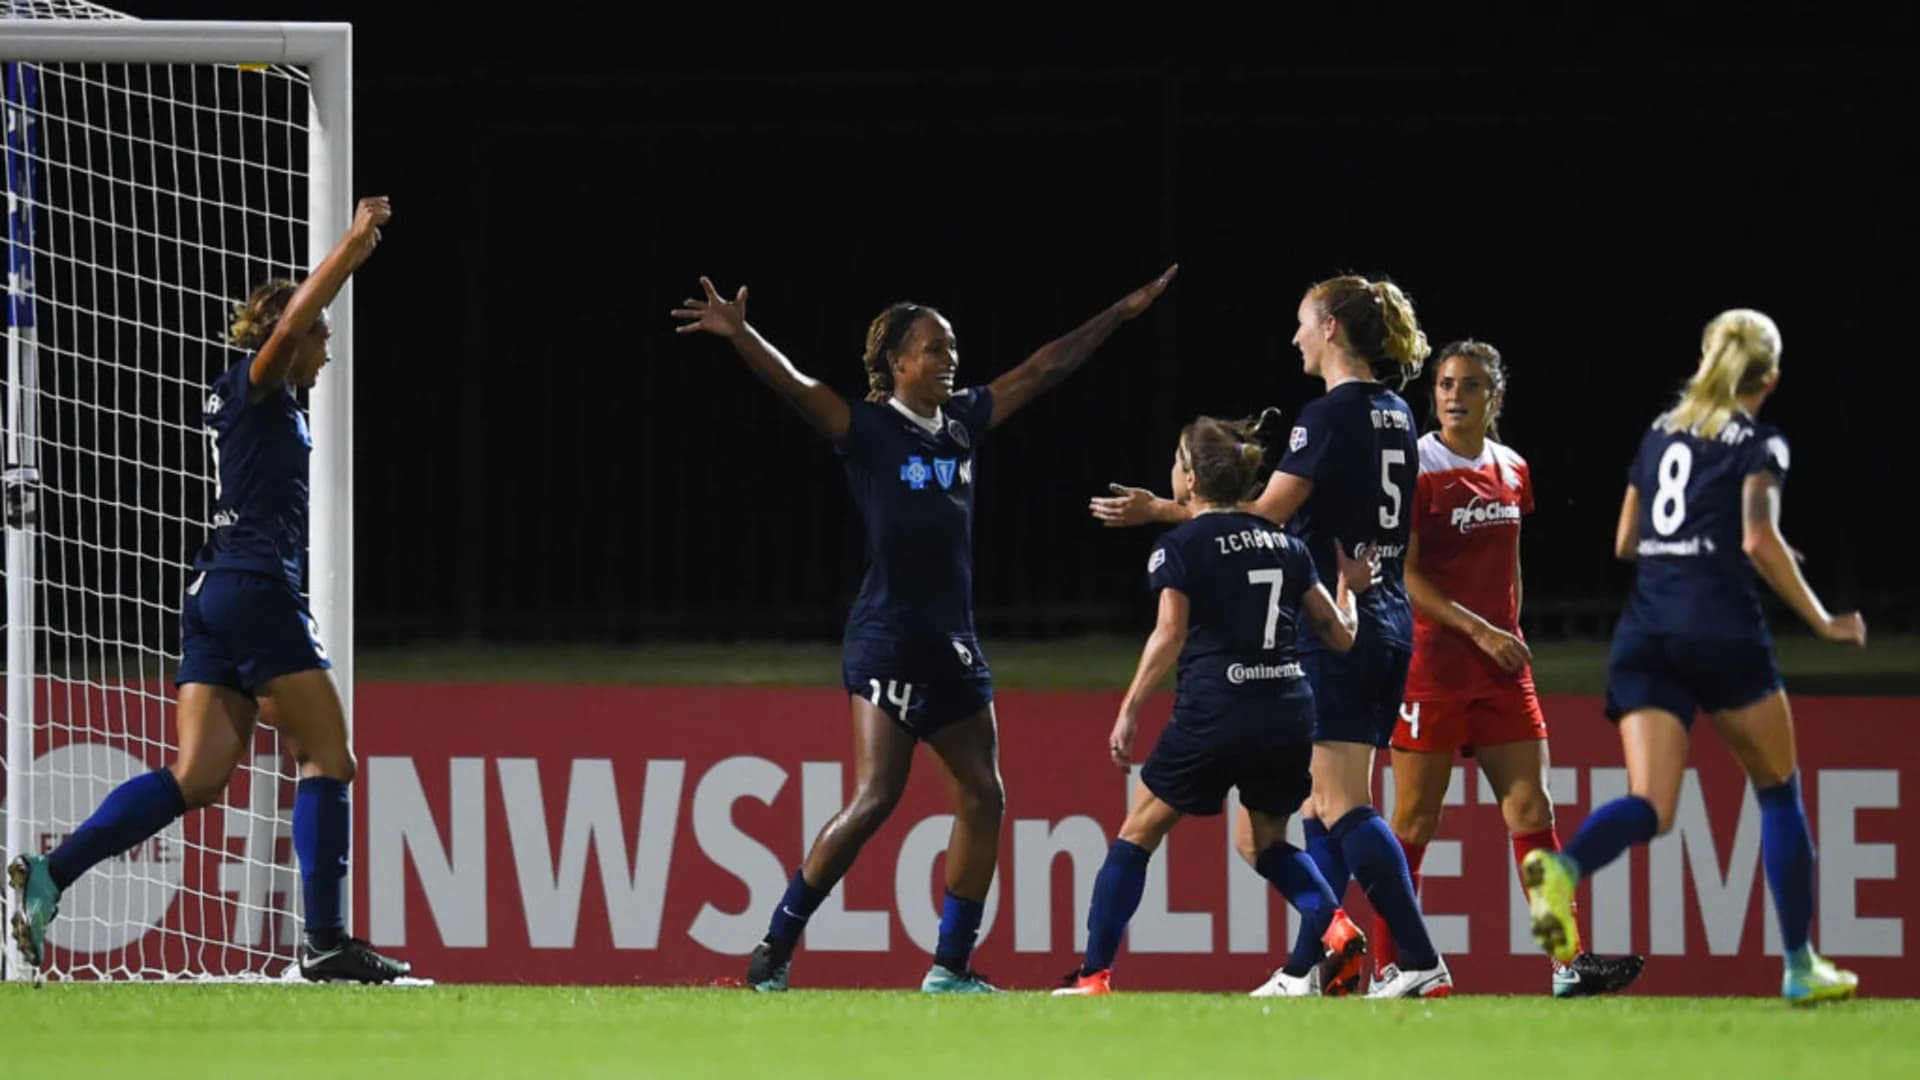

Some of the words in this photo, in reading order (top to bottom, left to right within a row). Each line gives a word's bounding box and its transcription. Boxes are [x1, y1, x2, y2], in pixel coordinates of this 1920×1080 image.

[1379, 450, 1405, 529] 5
[1652, 442, 1692, 536] 8
[1248, 569, 1283, 649] 7
[869, 678, 912, 721] 14
[1399, 701, 1420, 739] 4
